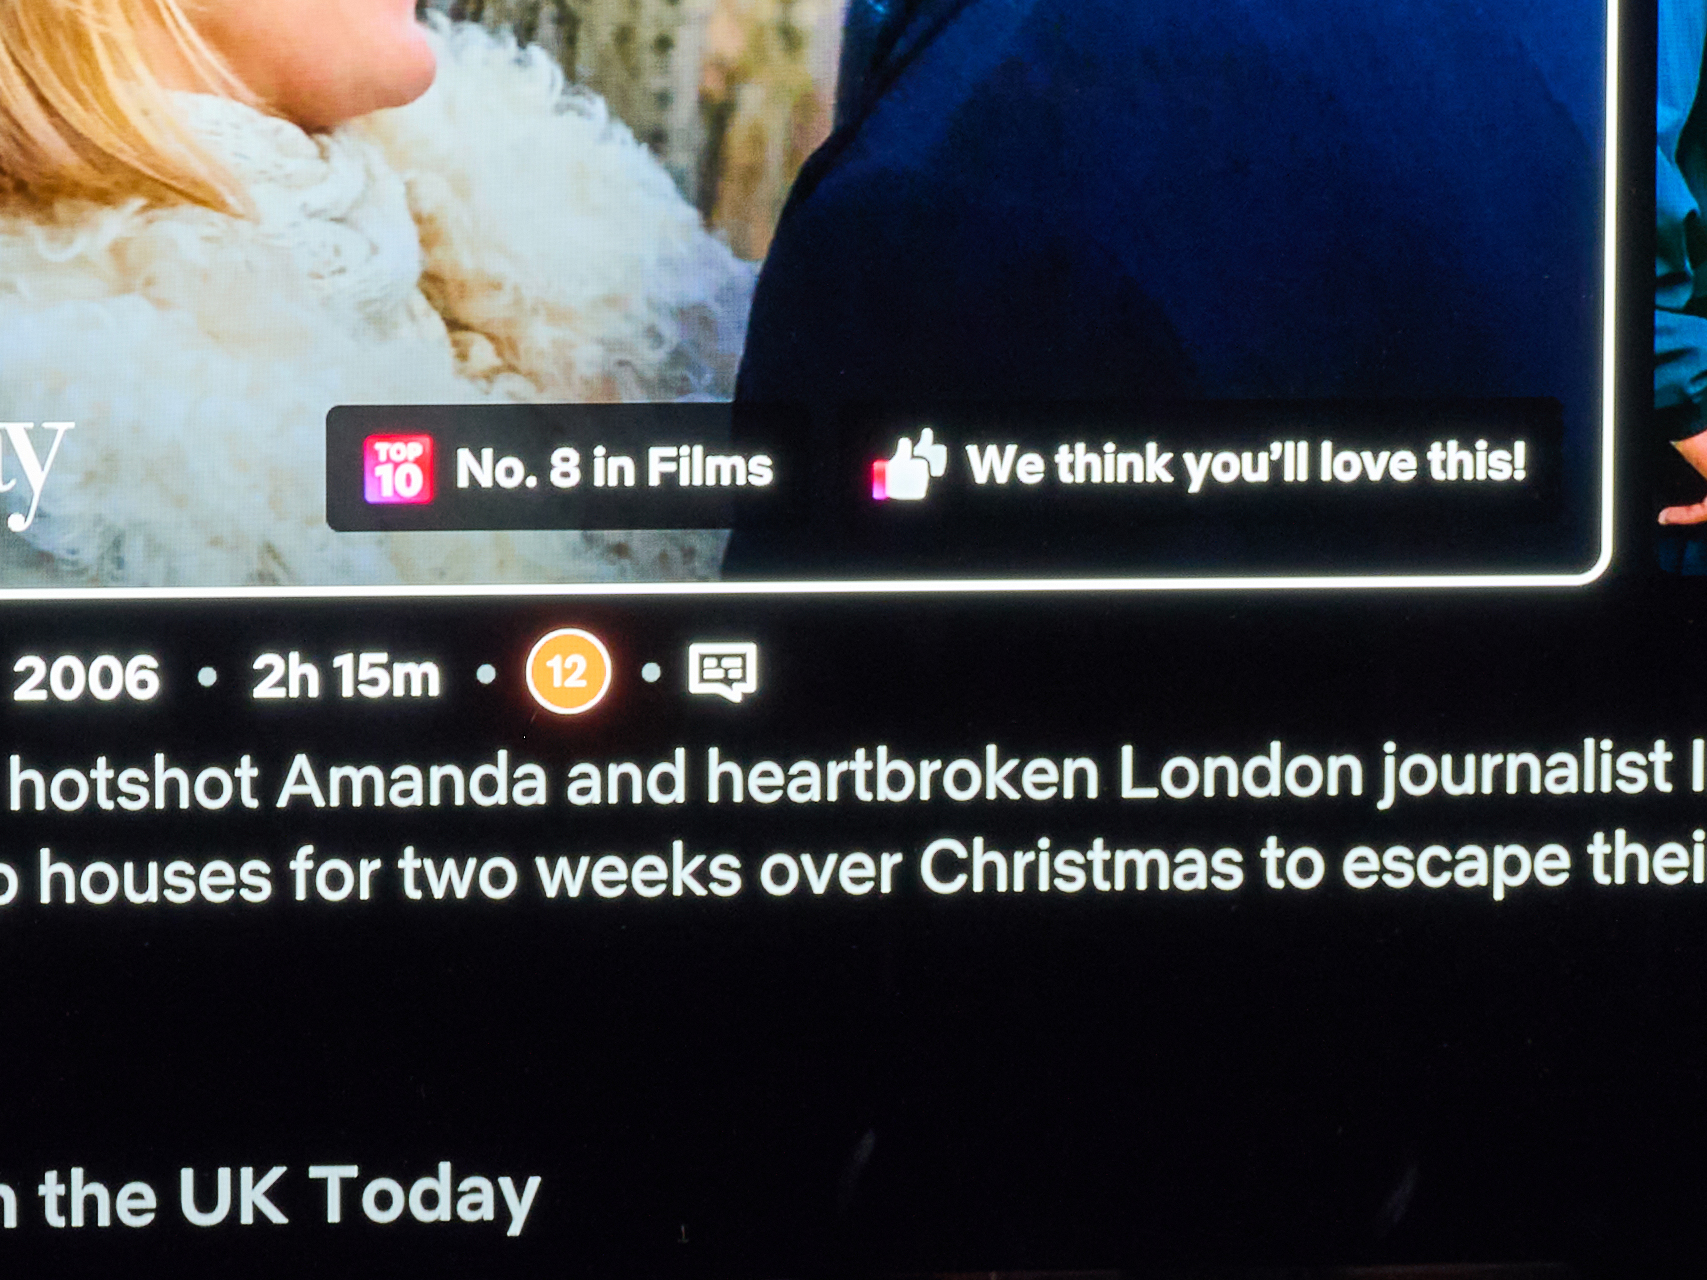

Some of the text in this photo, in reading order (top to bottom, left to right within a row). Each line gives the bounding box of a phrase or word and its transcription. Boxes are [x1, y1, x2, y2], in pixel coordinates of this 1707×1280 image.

[374, 440, 424, 462] TOP
[456, 444, 774, 488] No. 8 in Films
[965, 444, 1045, 484] We
[1055, 442, 1174, 484] think
[1321, 441, 1417, 482] love
[1427, 439, 1526, 482] this!
[374, 464, 423, 498] 10
[13, 655, 160, 701] 2006
[252, 652, 319, 699] 2h
[333, 652, 440, 698] 15m
[546, 655, 588, 689] 12
[9, 753, 259, 813] hotshot
[276, 750, 548, 808] Amanda
[566, 747, 685, 806] and
[708, 743, 1098, 803] heartbroken
[1120, 740, 1364, 801] London
[1376, 737, 1674, 810] journalist
[39, 847, 273, 904] houses
[289, 844, 381, 902] for
[397, 846, 519, 900] two
[535, 840, 743, 898] weeks
[760, 849, 903, 896] over
[919, 836, 1244, 894] Christmas
[1259, 836, 1325, 890] to
[1341, 838, 1571, 901] escape
[37, 1167, 157, 1228] the
[179, 1165, 290, 1227] UK
[307, 1161, 542, 1238] Today
